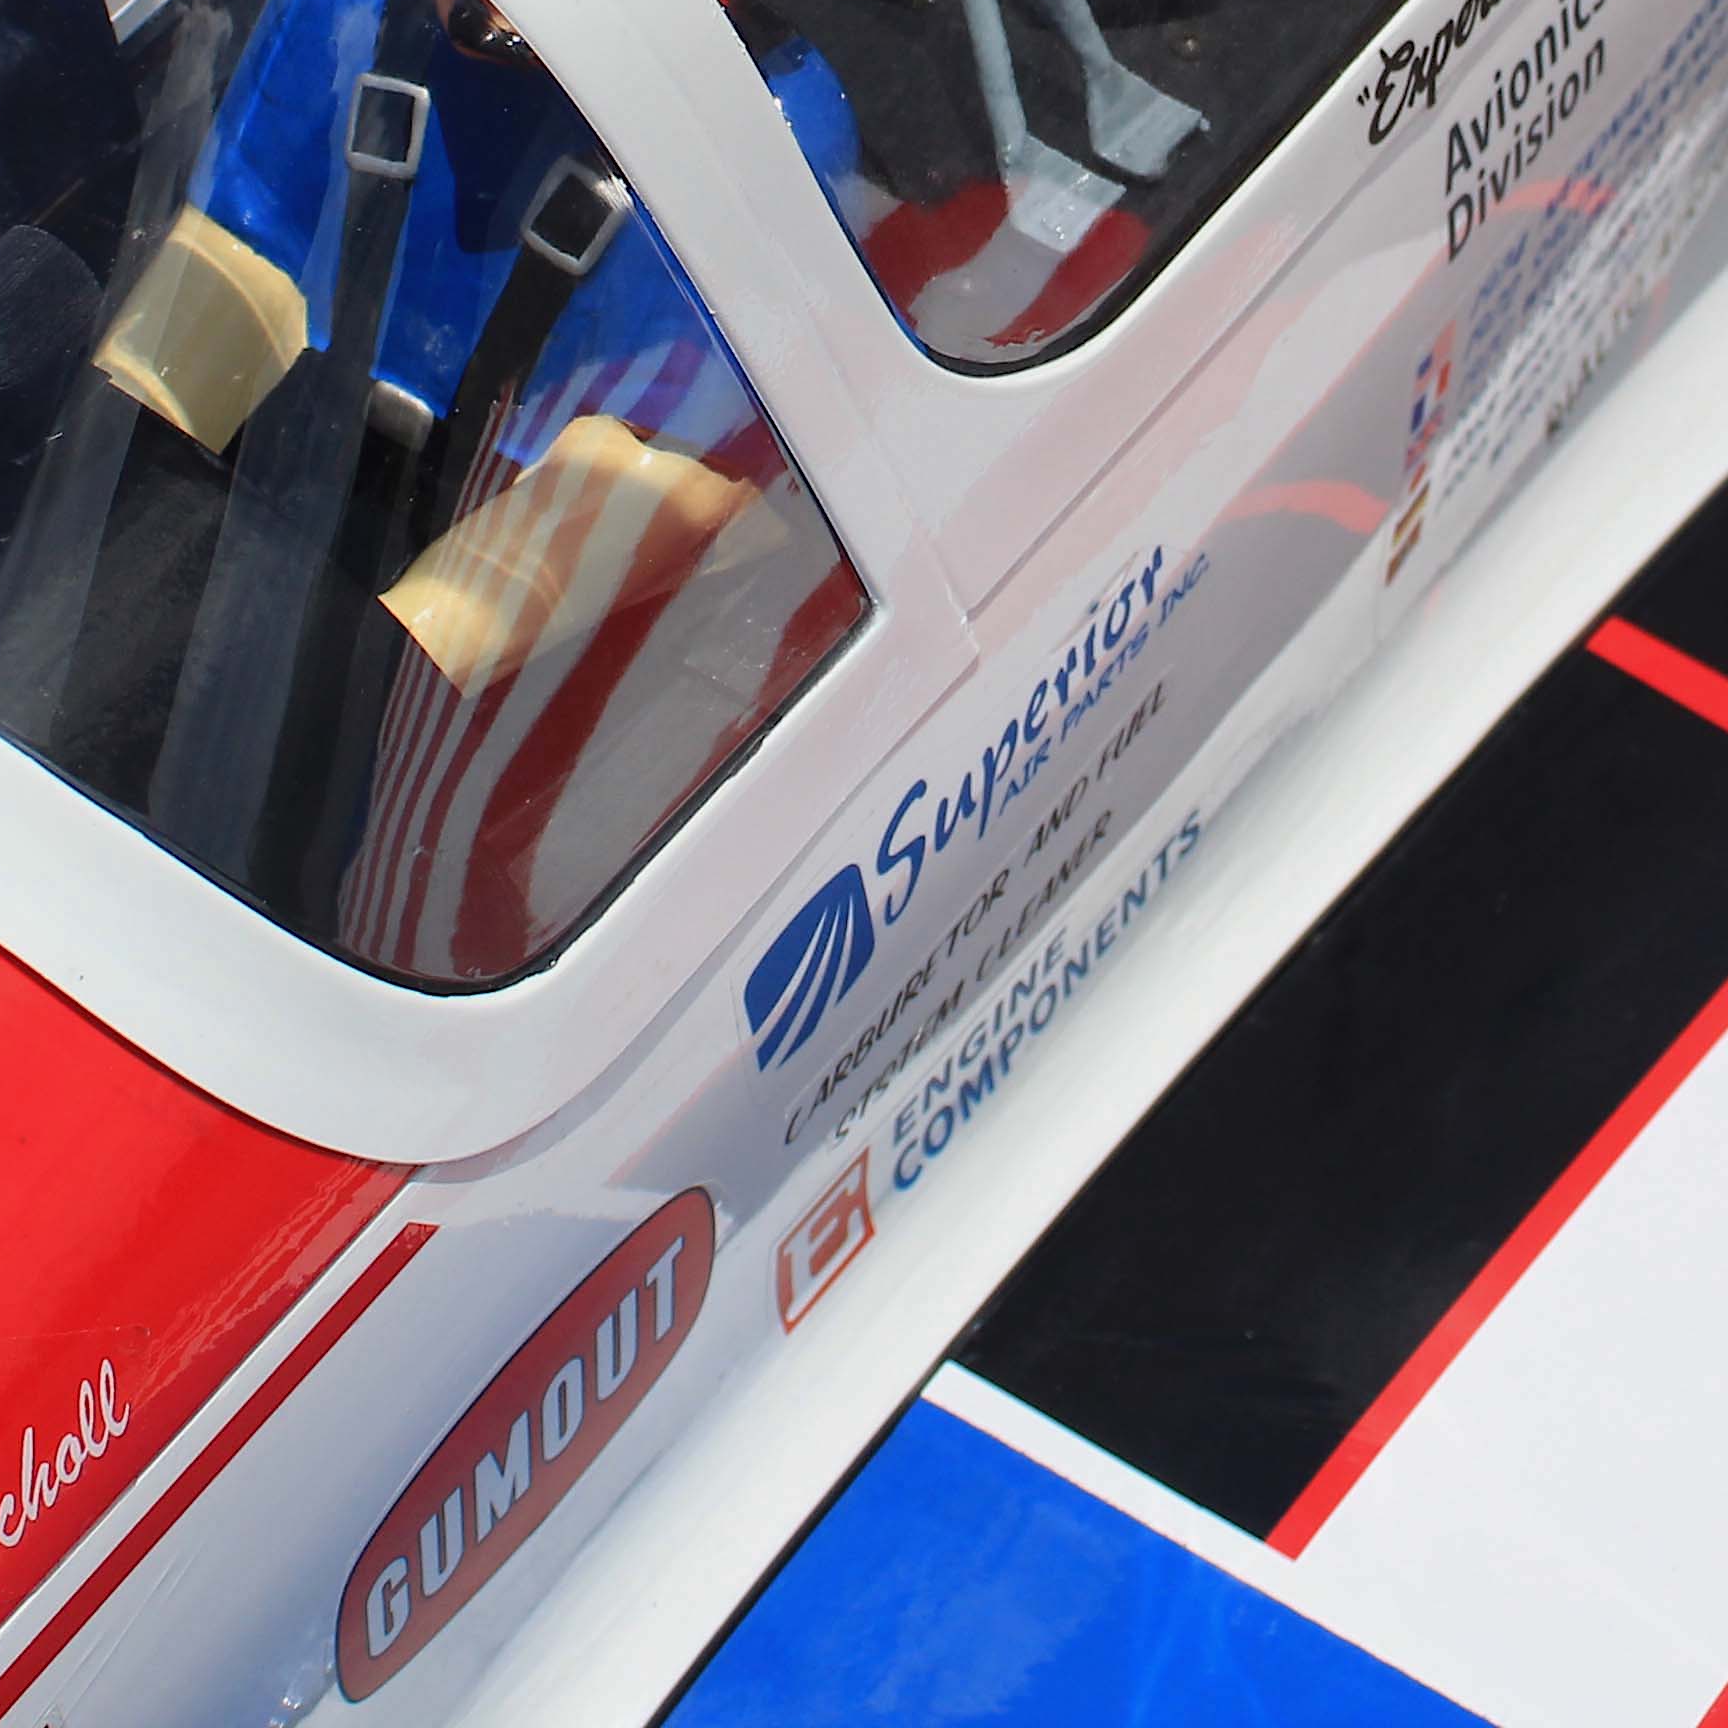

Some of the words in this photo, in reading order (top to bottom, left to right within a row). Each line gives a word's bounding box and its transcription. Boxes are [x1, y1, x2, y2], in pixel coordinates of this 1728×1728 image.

[1446, 36, 1606, 263] Division
[875, 544, 1163, 927] Superior
[998, 735, 1054, 818] AIR
[1060, 621, 1151, 745] PARTS
[784, 868, 1010, 1146] CARBURETOR
[1023, 775, 1090, 868] AND
[1097, 679, 1166, 781] FUEL
[891, 807, 1203, 1194] COMPONENTS
[892, 925, 1068, 1146] ENGINE
[364, 1235, 685, 1663] GUMOUT
